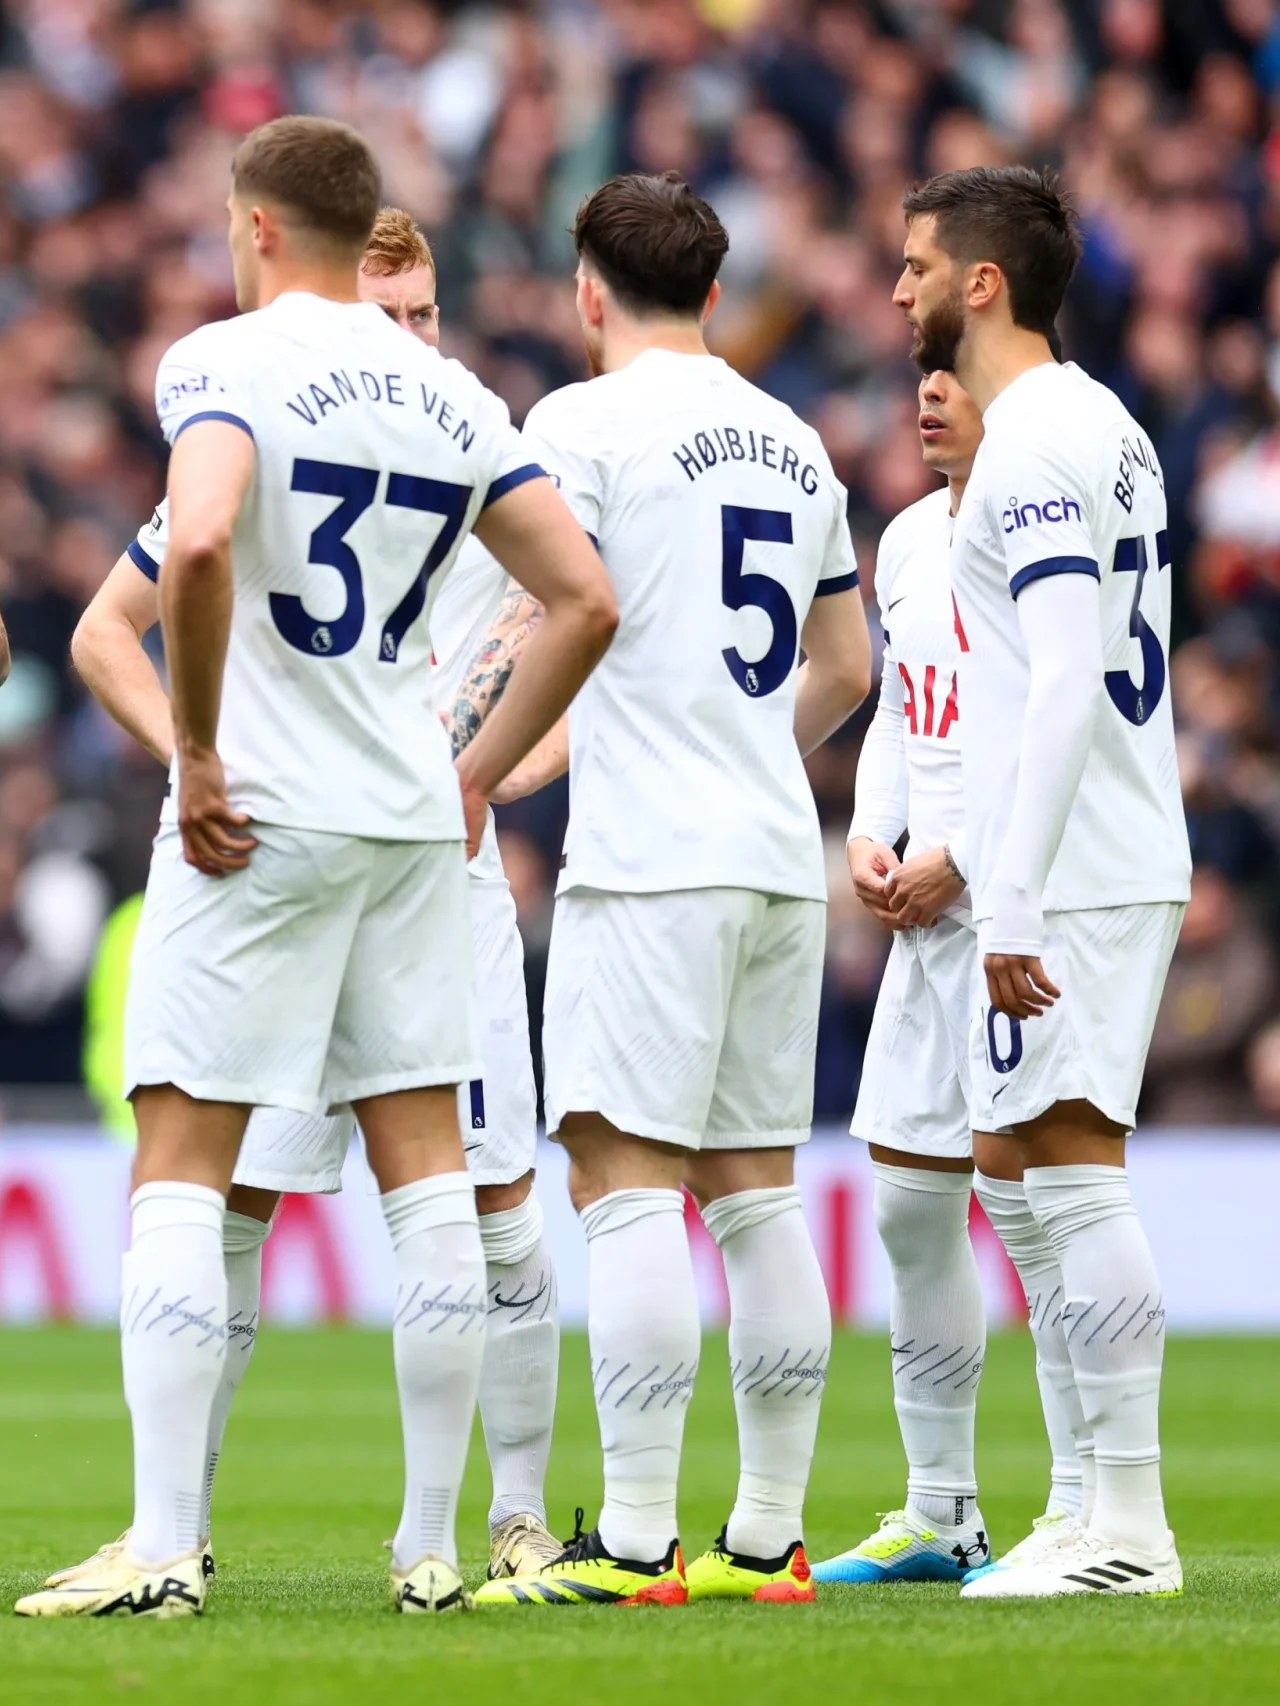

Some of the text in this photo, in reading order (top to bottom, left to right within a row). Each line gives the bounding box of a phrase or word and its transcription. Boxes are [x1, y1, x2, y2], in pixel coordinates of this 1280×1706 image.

[287, 369, 359, 427] VAN
[367, 373, 405, 406] DE
[420, 383, 477, 454] VEN
[673, 427, 819, 496] HØJBJERG
[1002, 495, 1082, 534] cinch
[268, 456, 475, 663] 37
[721, 504, 798, 698] 5
